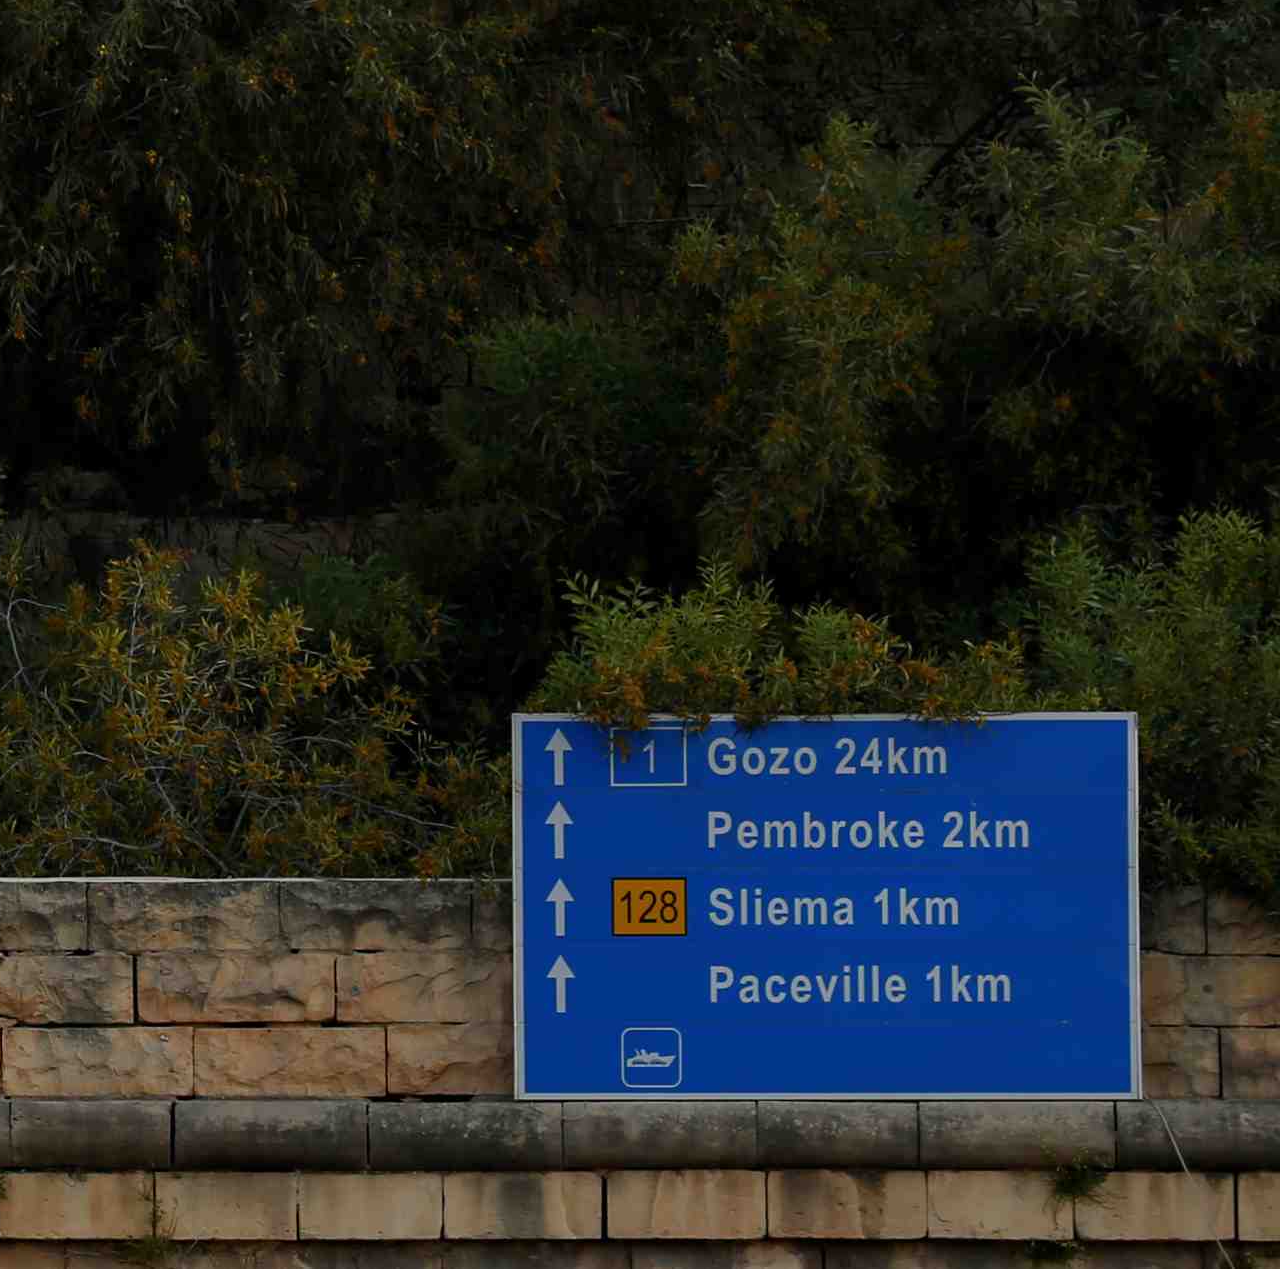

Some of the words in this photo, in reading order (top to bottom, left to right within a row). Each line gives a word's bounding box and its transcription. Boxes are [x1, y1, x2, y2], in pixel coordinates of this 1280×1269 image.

[642, 739, 655, 773] 1
[708, 737, 817, 775] Gozo
[835, 737, 948, 775] 24km
[708, 810, 925, 849] Pembroke
[943, 810, 1030, 848] 2km
[619, 890, 679, 924] 128
[708, 888, 854, 926] Sliema
[874, 888, 960, 925] 1km
[709, 965, 907, 1004] Paceville
[927, 966, 1012, 1003] 1km
